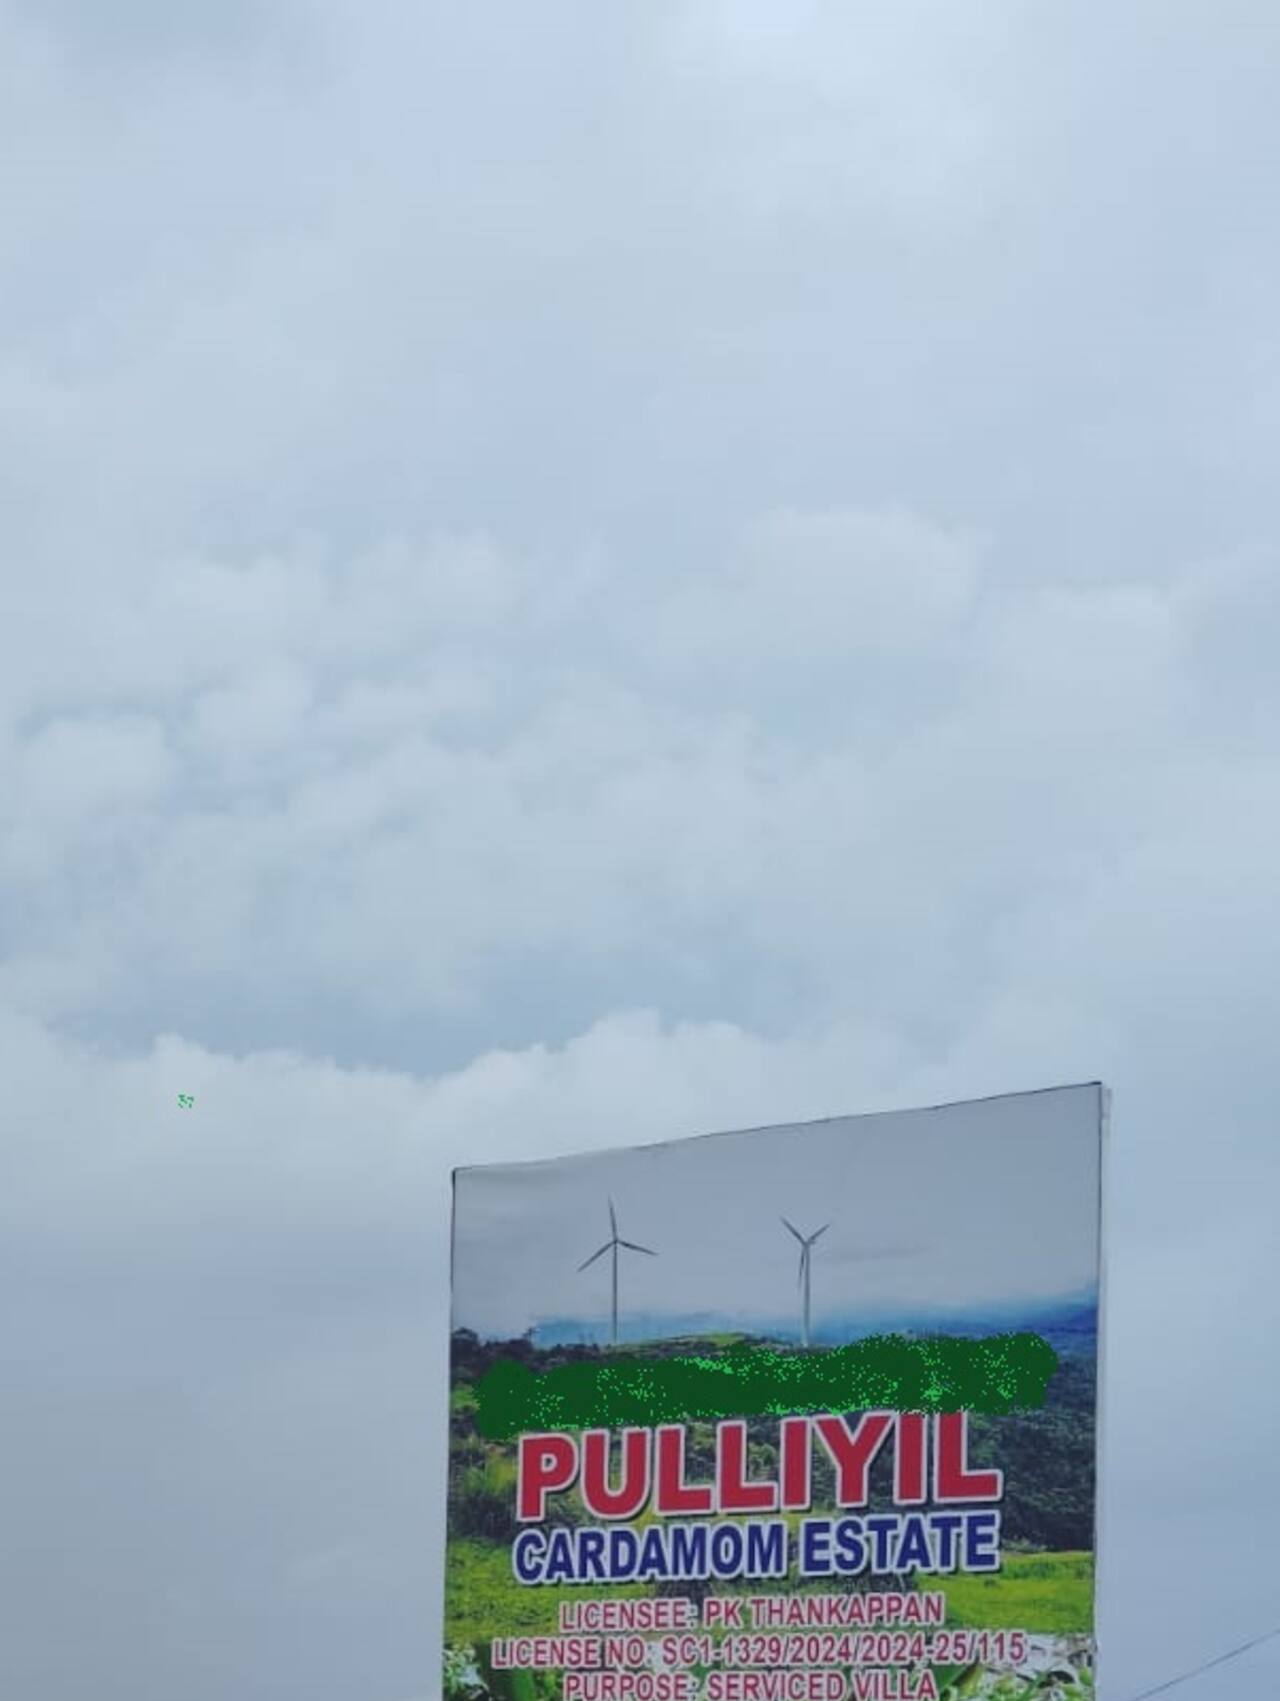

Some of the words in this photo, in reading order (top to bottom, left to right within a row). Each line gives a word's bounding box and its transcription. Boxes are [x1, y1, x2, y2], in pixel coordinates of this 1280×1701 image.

[517, 1412, 1003, 1520] PULLIYIL
[513, 1522, 785, 1583] CARDAMOM
[802, 1510, 1001, 1577] ESTATE
[560, 1599, 696, 1631] LICENSEE:
[704, 1598, 743, 1627] PK
[751, 1593, 944, 1627] THANKAPPAN
[492, 1637, 600, 1668] LICENSE
[606, 1636, 652, 1667] NO:
[660, 1630, 1028, 1667] SC1-1329/2024/2024-25/115
[853, 1669, 939, 1701] VILLA
